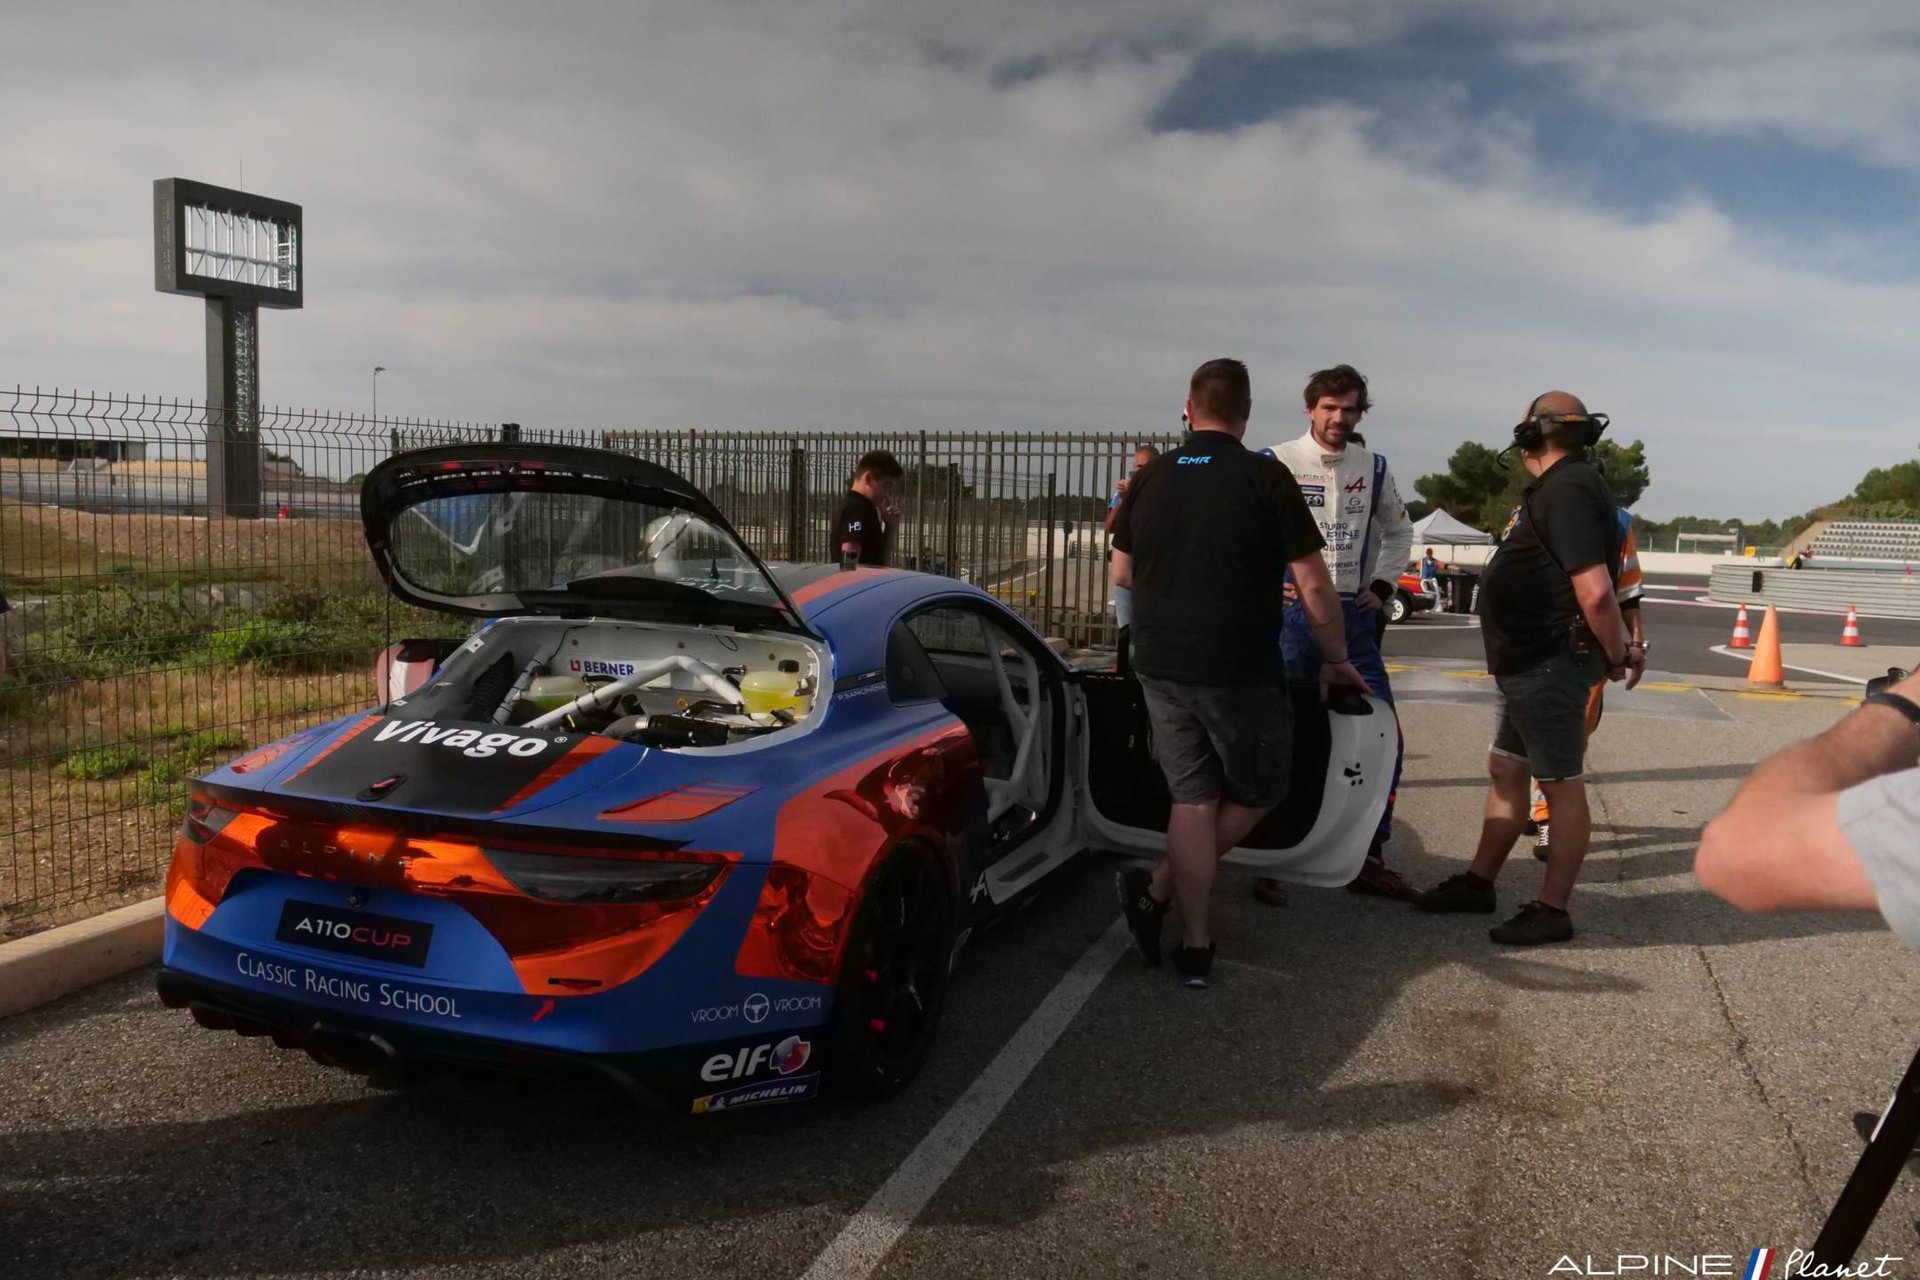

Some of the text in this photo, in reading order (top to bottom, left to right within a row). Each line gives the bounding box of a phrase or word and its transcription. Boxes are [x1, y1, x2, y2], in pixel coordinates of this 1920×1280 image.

[1176, 456, 1212, 465] CMR
[583, 660, 634, 676] BERNER
[279, 838, 414, 868] ALPINE
[237, 952, 461, 1018] CLASSIC RACING SCHOOL
[690, 996, 822, 1024] VROOM VROOM
[700, 1043, 771, 1083] elf
[729, 1083, 808, 1106] MICHELIN
